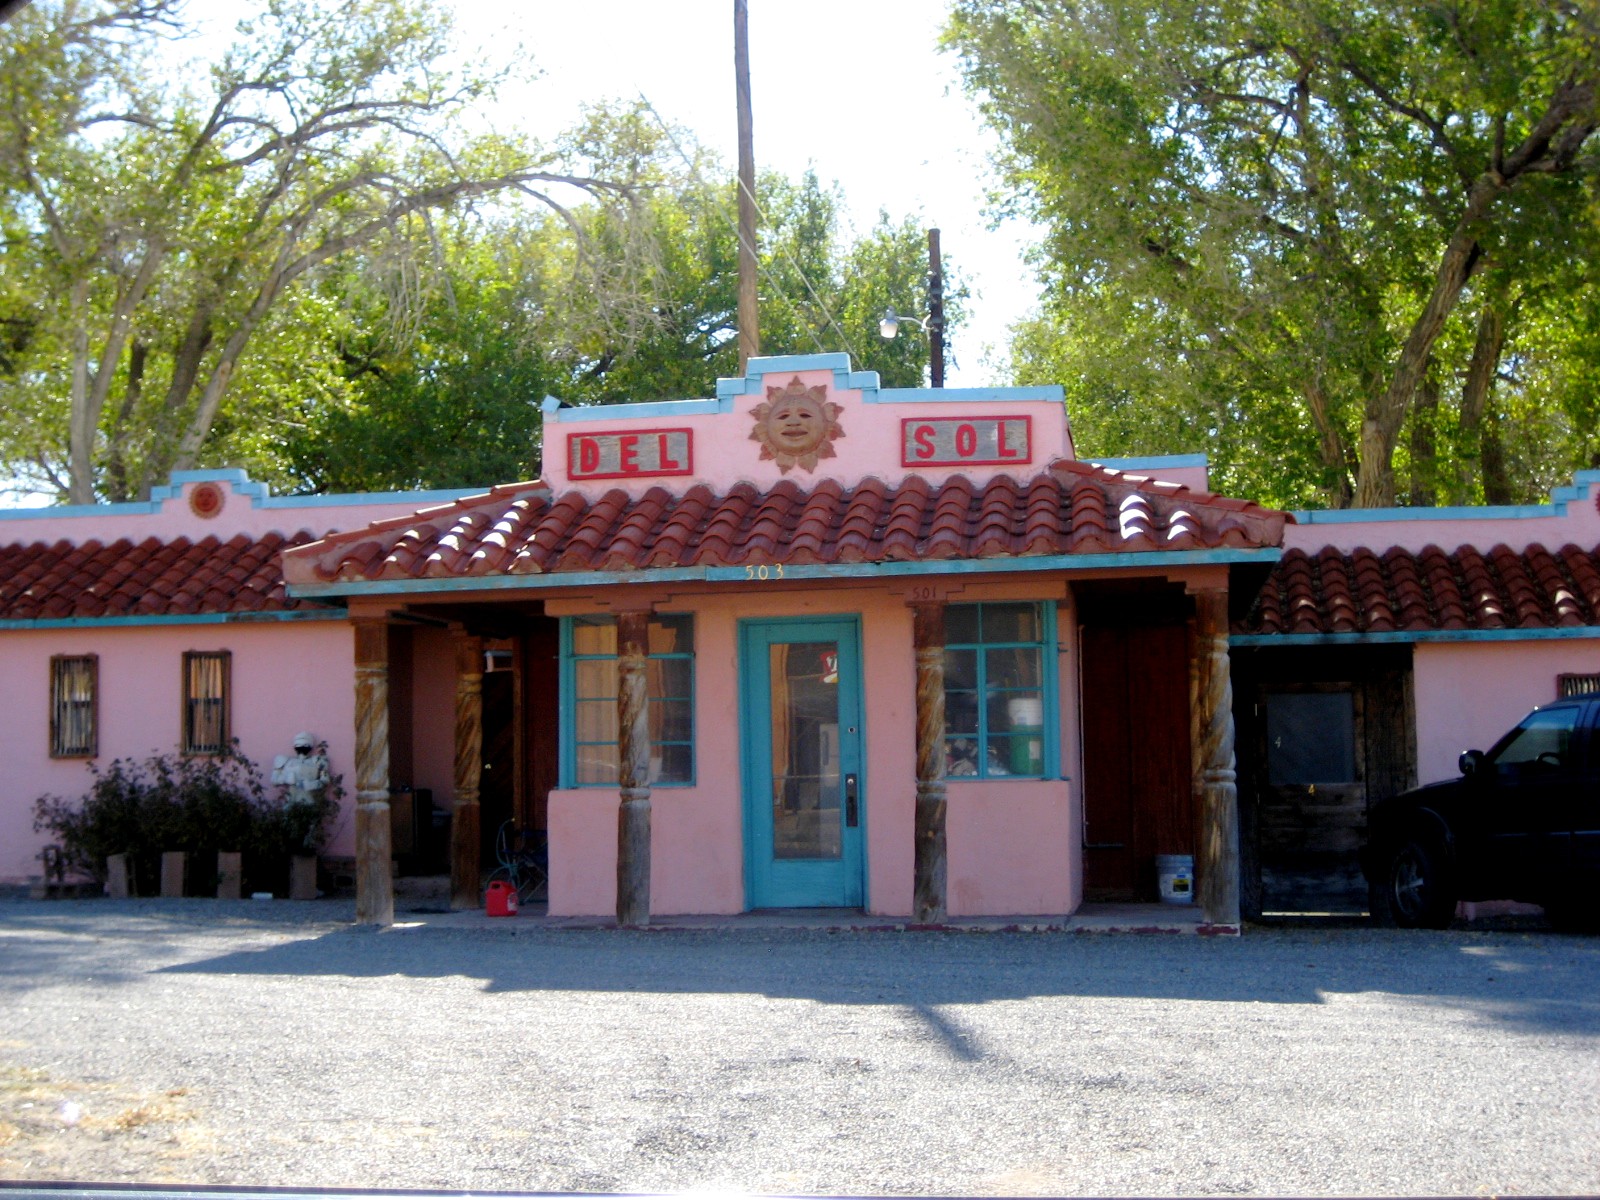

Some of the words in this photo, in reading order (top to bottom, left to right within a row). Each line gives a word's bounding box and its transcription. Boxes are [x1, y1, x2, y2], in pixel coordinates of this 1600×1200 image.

[580, 434, 679, 473] DEL
[914, 421, 1017, 459] SOL
[745, 563, 784, 580] 503
[912, 586, 936, 599] 501
